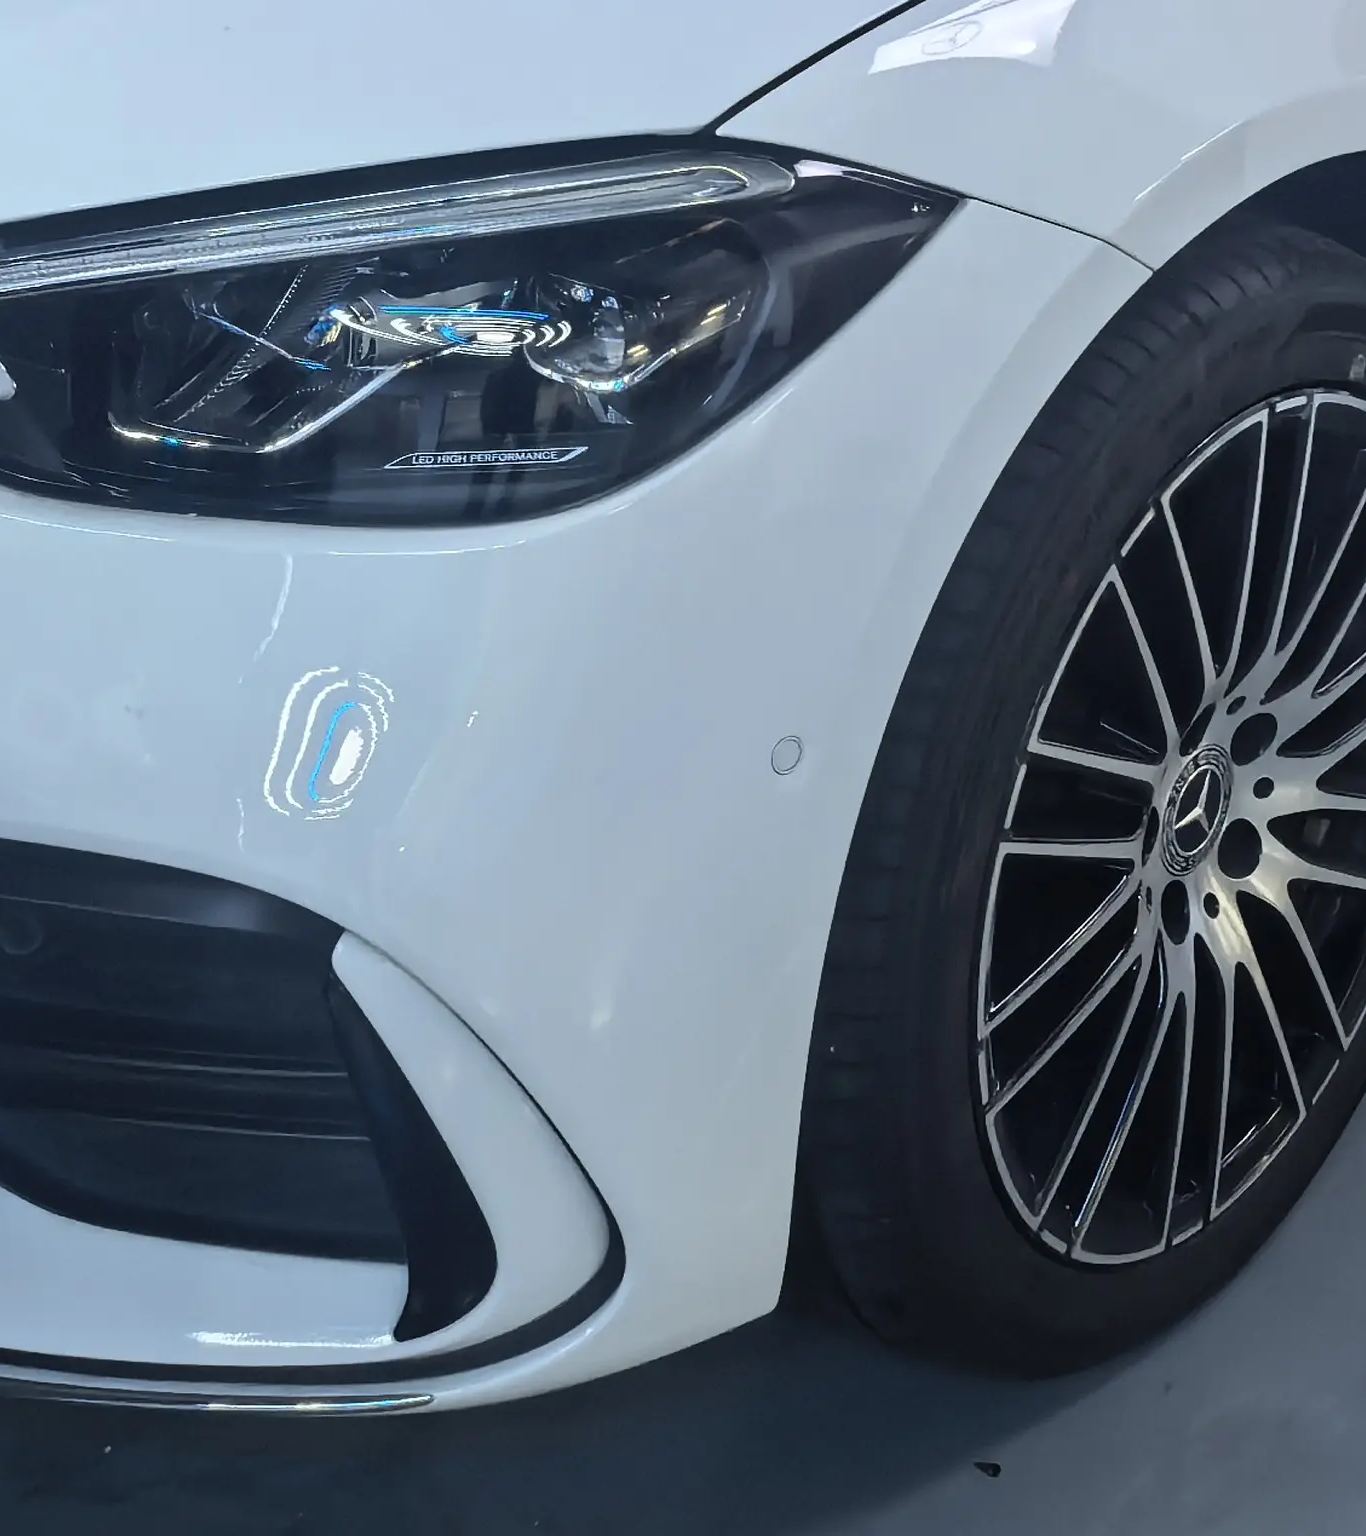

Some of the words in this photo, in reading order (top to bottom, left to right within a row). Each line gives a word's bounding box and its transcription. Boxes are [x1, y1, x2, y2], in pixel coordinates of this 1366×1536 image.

[412, 453, 435, 465] LED
[437, 453, 467, 464] HIGH
[470, 451, 558, 463] PERFORMANCE
